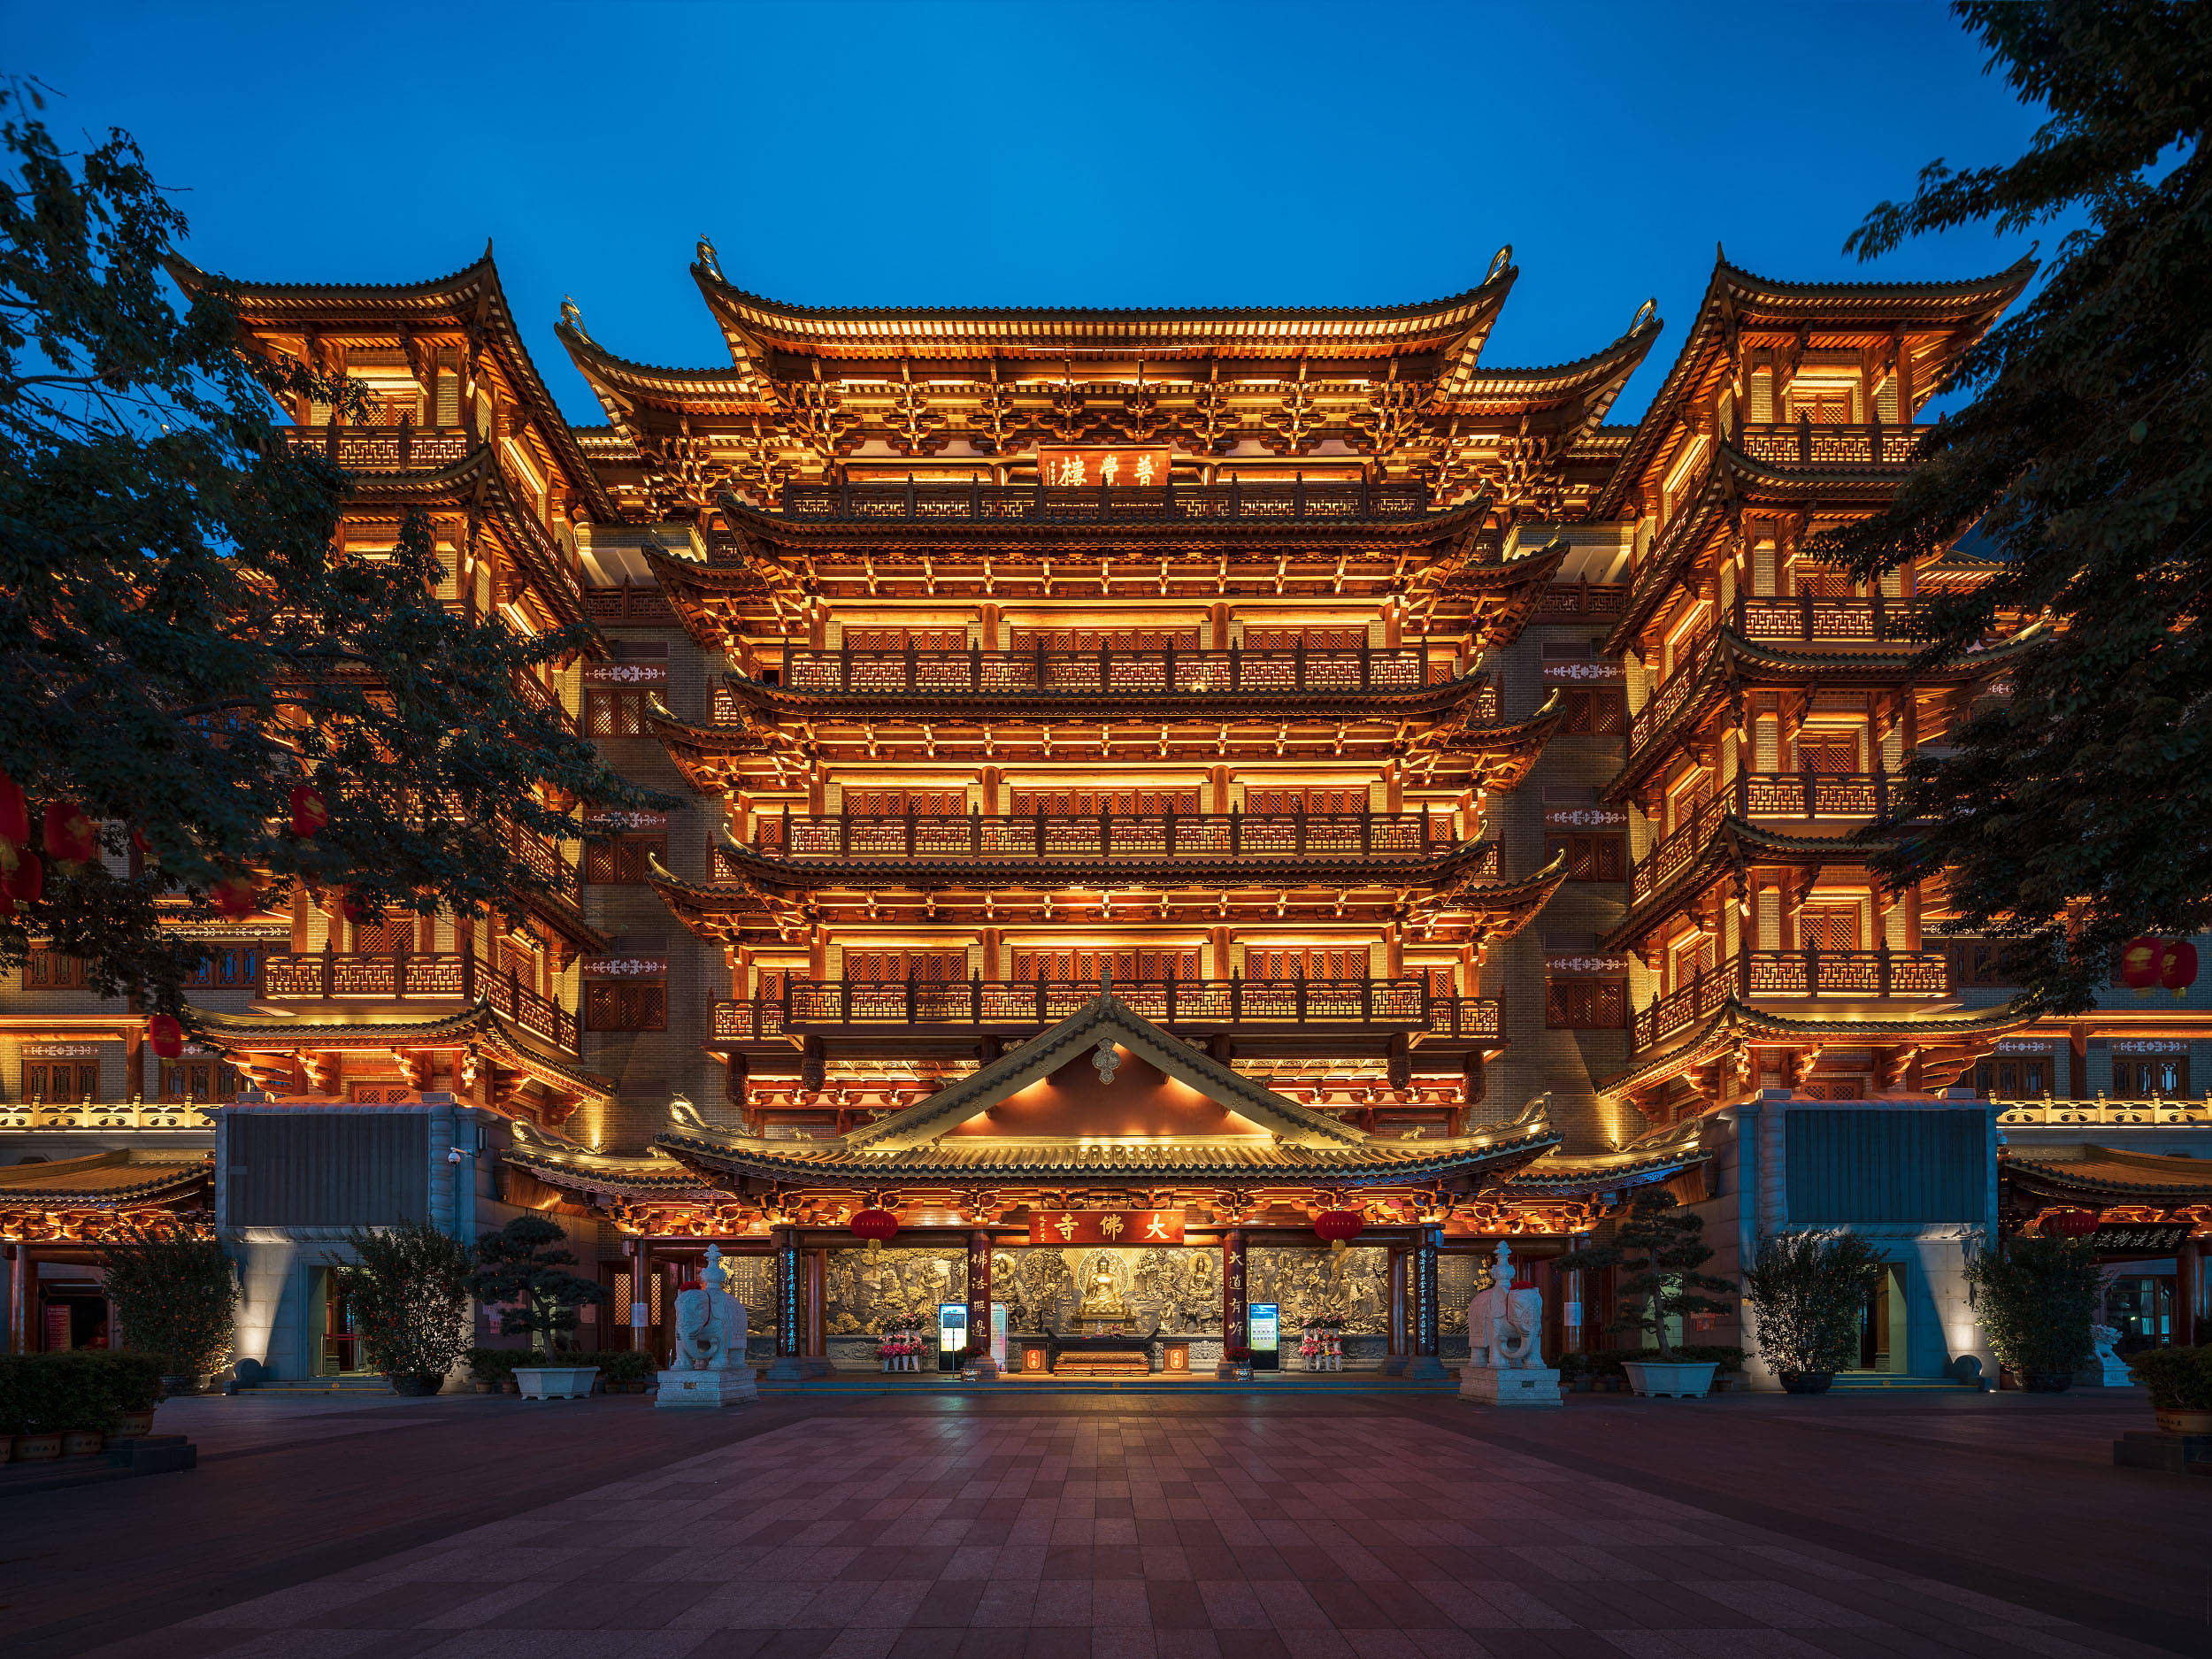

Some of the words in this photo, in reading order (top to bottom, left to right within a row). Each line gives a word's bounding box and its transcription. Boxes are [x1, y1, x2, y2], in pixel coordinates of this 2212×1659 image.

[1054, 1213, 1170, 1242] 大佛寺
[971, 1249, 987, 1337] 佛法無邊
